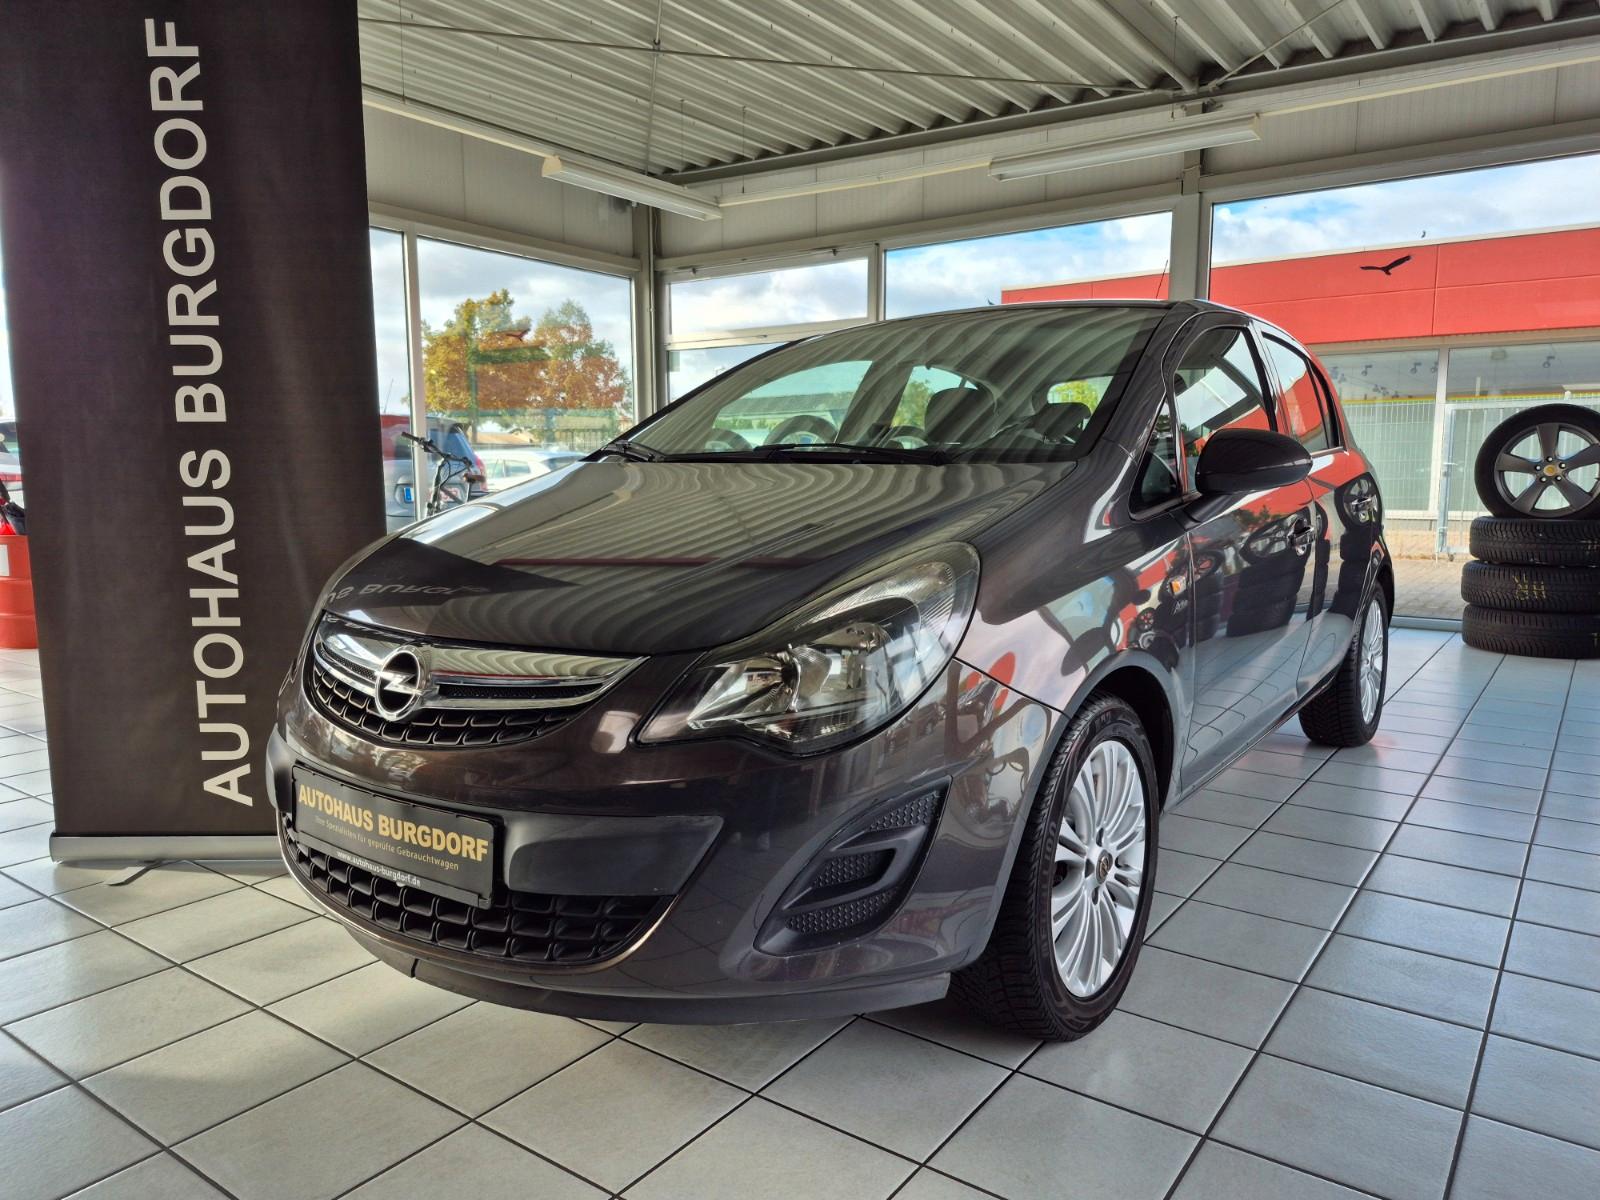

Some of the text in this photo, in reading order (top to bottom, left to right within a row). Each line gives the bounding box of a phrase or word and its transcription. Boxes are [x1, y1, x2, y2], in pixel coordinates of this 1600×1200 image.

[144, 17, 253, 806] AUTOHAUS BURGDORF
[298, 784, 489, 862] AUTOHAUS BURGDORF
[336, 850, 421, 886] www.autohaus-burgdorf.de
[396, 846, 459, 871] Gebrauchtwagen
